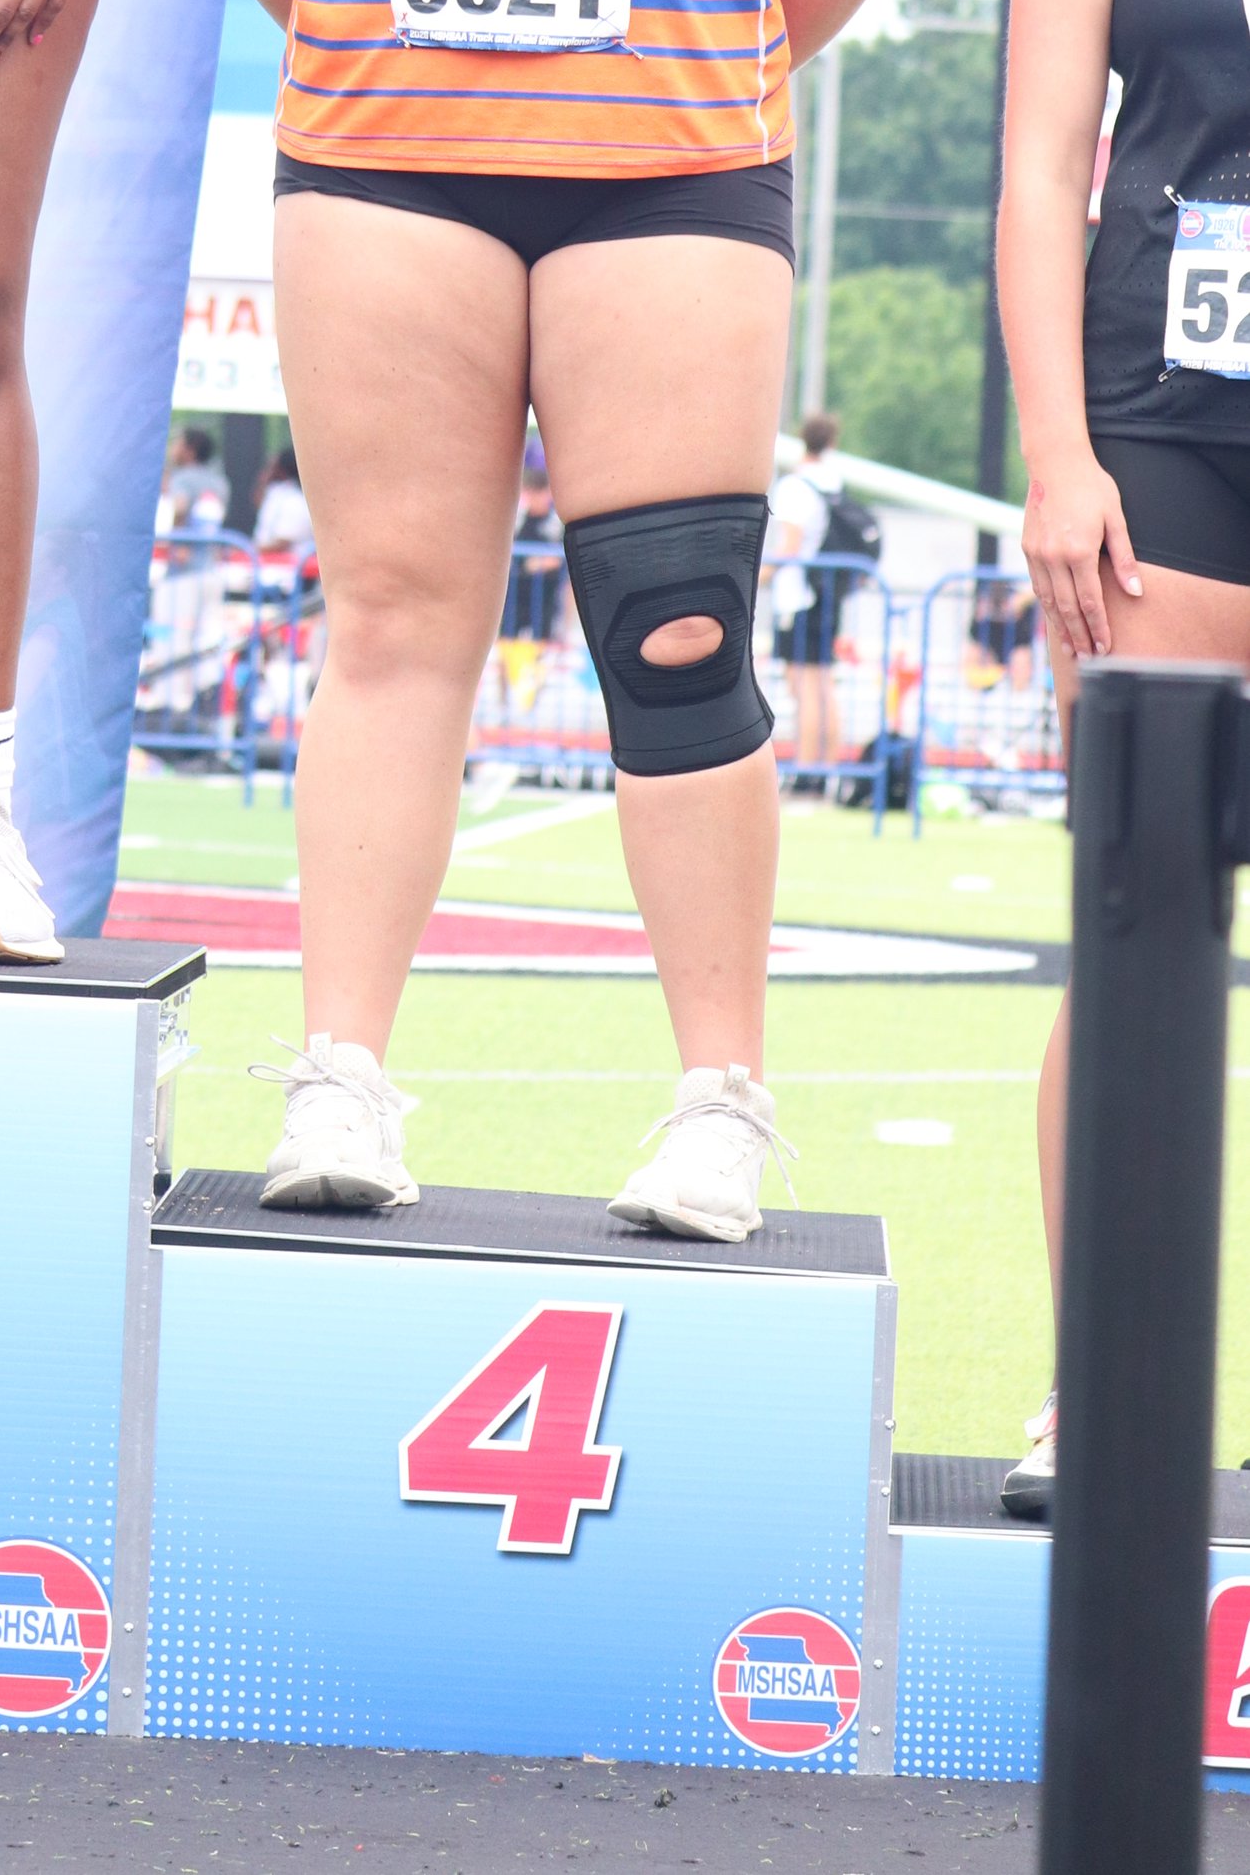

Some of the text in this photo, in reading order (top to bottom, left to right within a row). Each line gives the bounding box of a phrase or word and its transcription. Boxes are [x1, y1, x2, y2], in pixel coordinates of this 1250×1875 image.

[430, 30, 468, 43] MSHSAA
[469, 32, 493, 43] Track
[495, 33, 512, 44] and
[513, 33, 537, 45] Field
[1213, 218, 1235, 231] 1926
[398, 1299, 625, 1555] 4
[737, 1664, 836, 1699] MSHSAA
